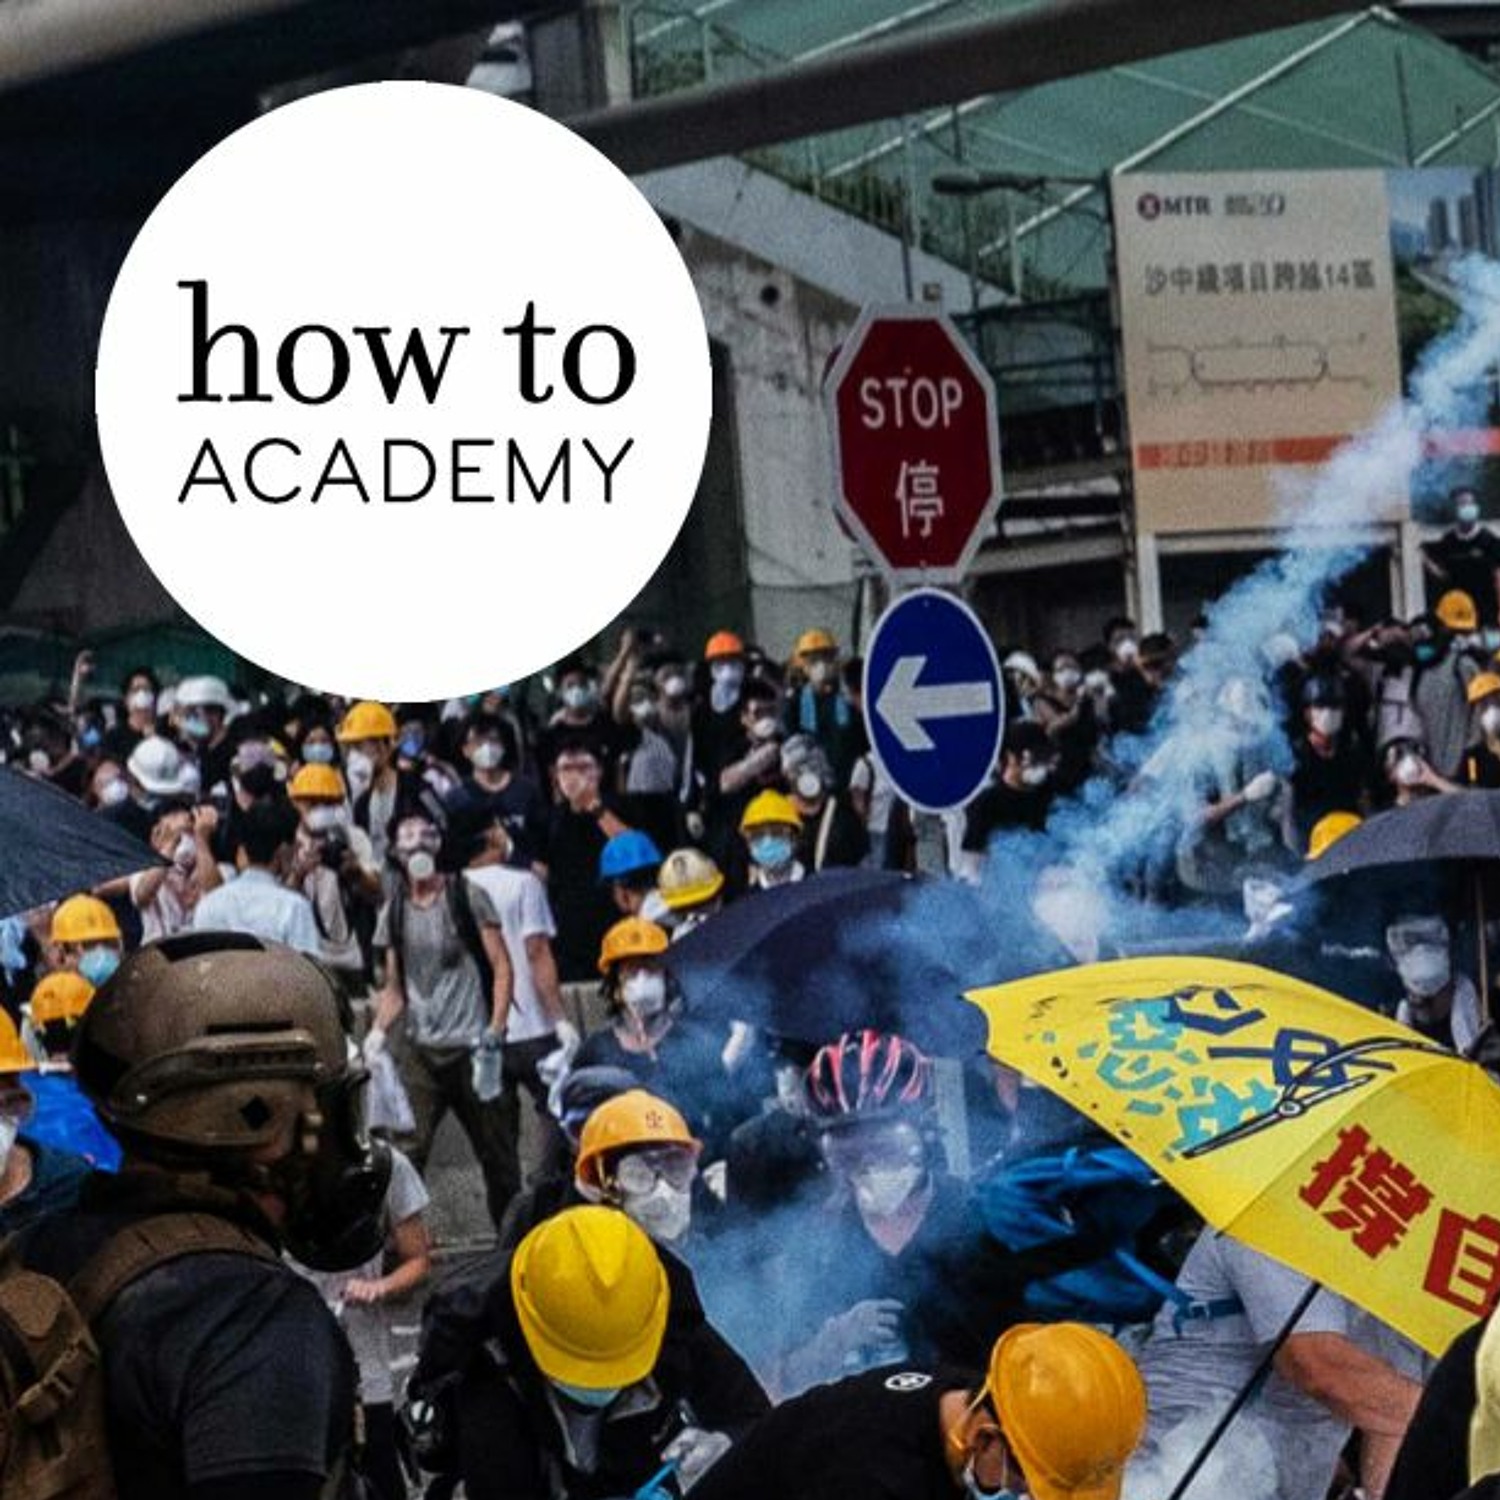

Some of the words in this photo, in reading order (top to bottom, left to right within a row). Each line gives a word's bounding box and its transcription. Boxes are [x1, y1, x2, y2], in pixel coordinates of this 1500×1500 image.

[1163, 195, 1210, 216] MTR
[860, 377, 963, 429] STOP
[895, 460, 944, 538] 停
